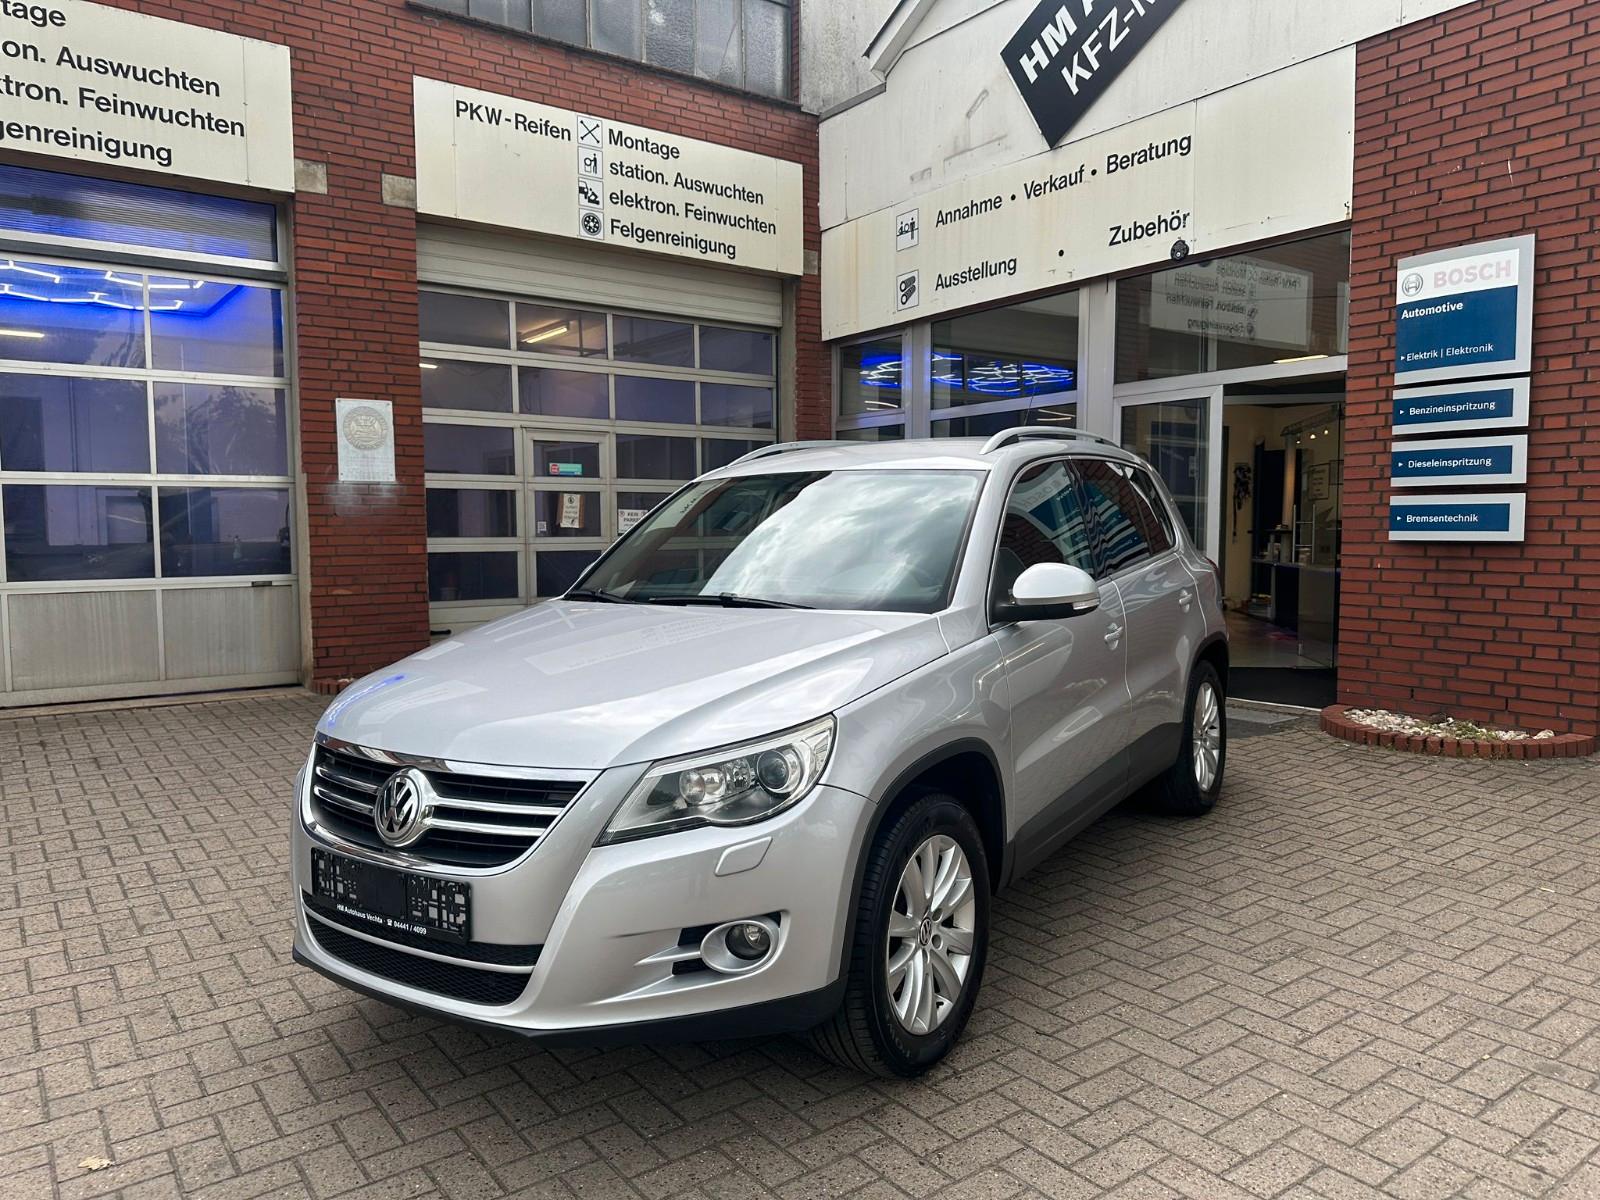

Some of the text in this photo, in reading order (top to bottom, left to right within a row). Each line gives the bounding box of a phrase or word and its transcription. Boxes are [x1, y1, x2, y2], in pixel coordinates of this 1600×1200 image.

[1, 0, 66, 27] tage
[1019, 5, 1077, 84] HM
[56, 46, 220, 97] Auswuchten
[0, 75, 245, 137] tron. Feinwuchten
[456, 100, 571, 141] PKW-Reifen
[608, 129, 680, 159] Montage
[609, 162, 764, 205] station. Auswuchten
[935, 134, 1192, 228] Annahme Verkauf Beratung
[609, 190, 777, 235] elektron. Feinwuchten
[1109, 210, 1190, 246] Zubehör
[610, 218, 737, 259] Felgenreinigung
[935, 256, 1017, 291] Ausstellung
[1433, 260, 1511, 288] BOSCH
[1402, 302, 1463, 319] Automotive
[1406, 350, 1438, 361] Elektrik
[1446, 343, 1494, 356] Elektronik
[1409, 400, 1495, 416] Benzineinspritzung
[1408, 456, 1492, 470] Dieseleinspritzung
[1406, 513, 1478, 523] Bremsentechnik
[345, 907, 366, 918] Autohaus
[366, 913, 383, 924] Vechta
[393, 920, 409, 931] 04441
[413, 925, 427, 935] 4099
